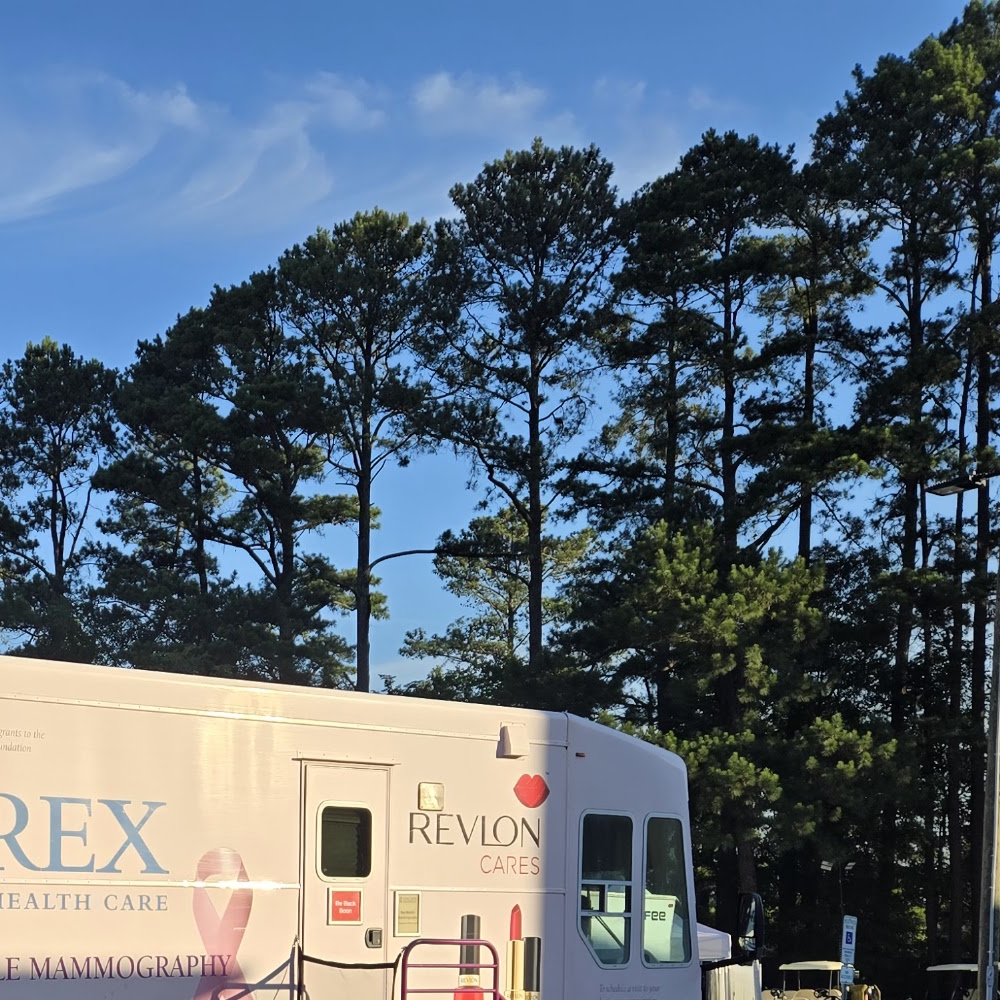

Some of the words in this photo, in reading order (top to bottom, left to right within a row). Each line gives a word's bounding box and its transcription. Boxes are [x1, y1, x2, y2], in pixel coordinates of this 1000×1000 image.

[24, 730, 32, 738] to
[33, 729, 46, 740] the
[408, 811, 541, 849] REVLON
[480, 854, 541, 876] CARES
[104, 894, 169, 912] CARE
[29, 954, 232, 982] MAMMOGRAPHY
